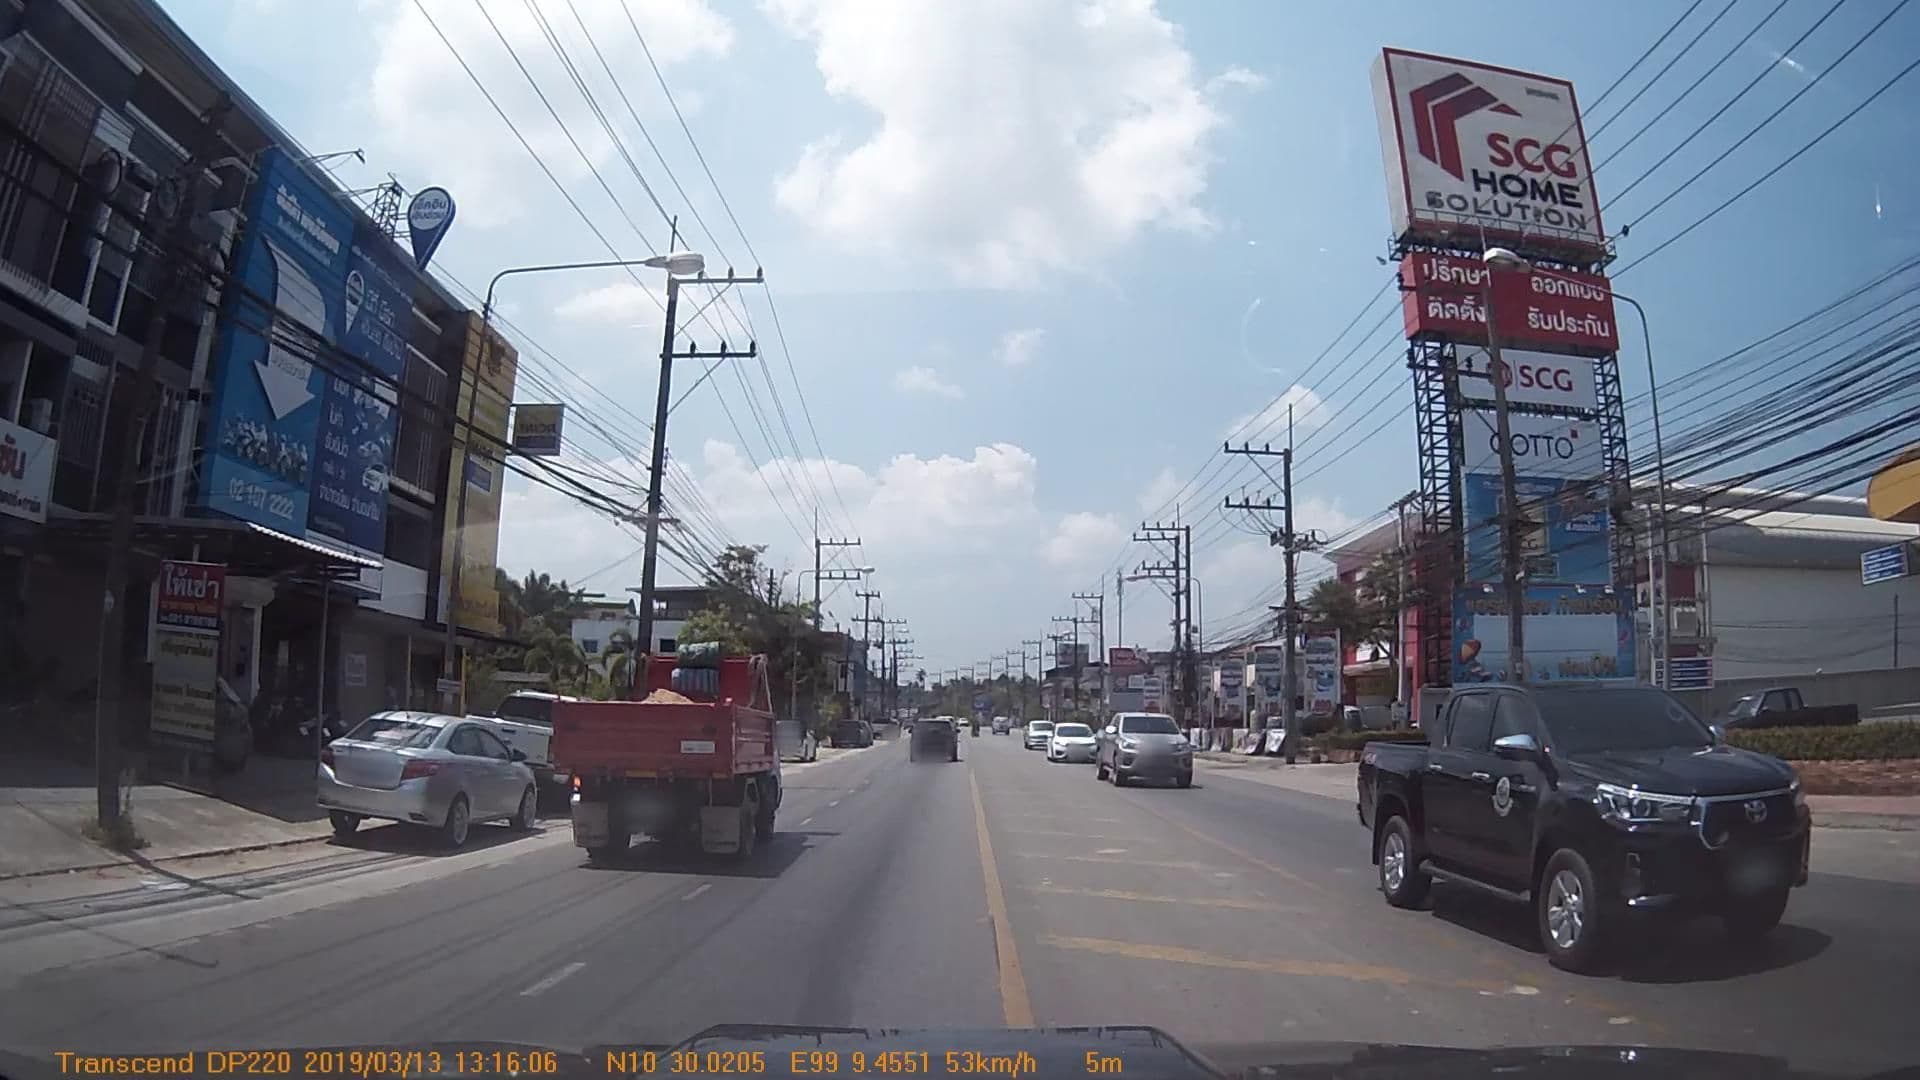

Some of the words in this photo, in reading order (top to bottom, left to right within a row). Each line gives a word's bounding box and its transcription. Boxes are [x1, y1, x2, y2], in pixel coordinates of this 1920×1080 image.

[1486, 132, 1577, 178] SCG
[1471, 168, 1584, 209] HOME
[1425, 190, 1588, 231] SOLUTION
[1423, 257, 1492, 289] ปรึกษา
[1530, 275, 1606, 302] ออกแบบ
[1427, 295, 1487, 324] ติดตั้ง
[1527, 306, 1611, 339] รับประกัน
[1519, 367, 1574, 392] SCG
[164, 562, 220, 599] ให้เช่า
